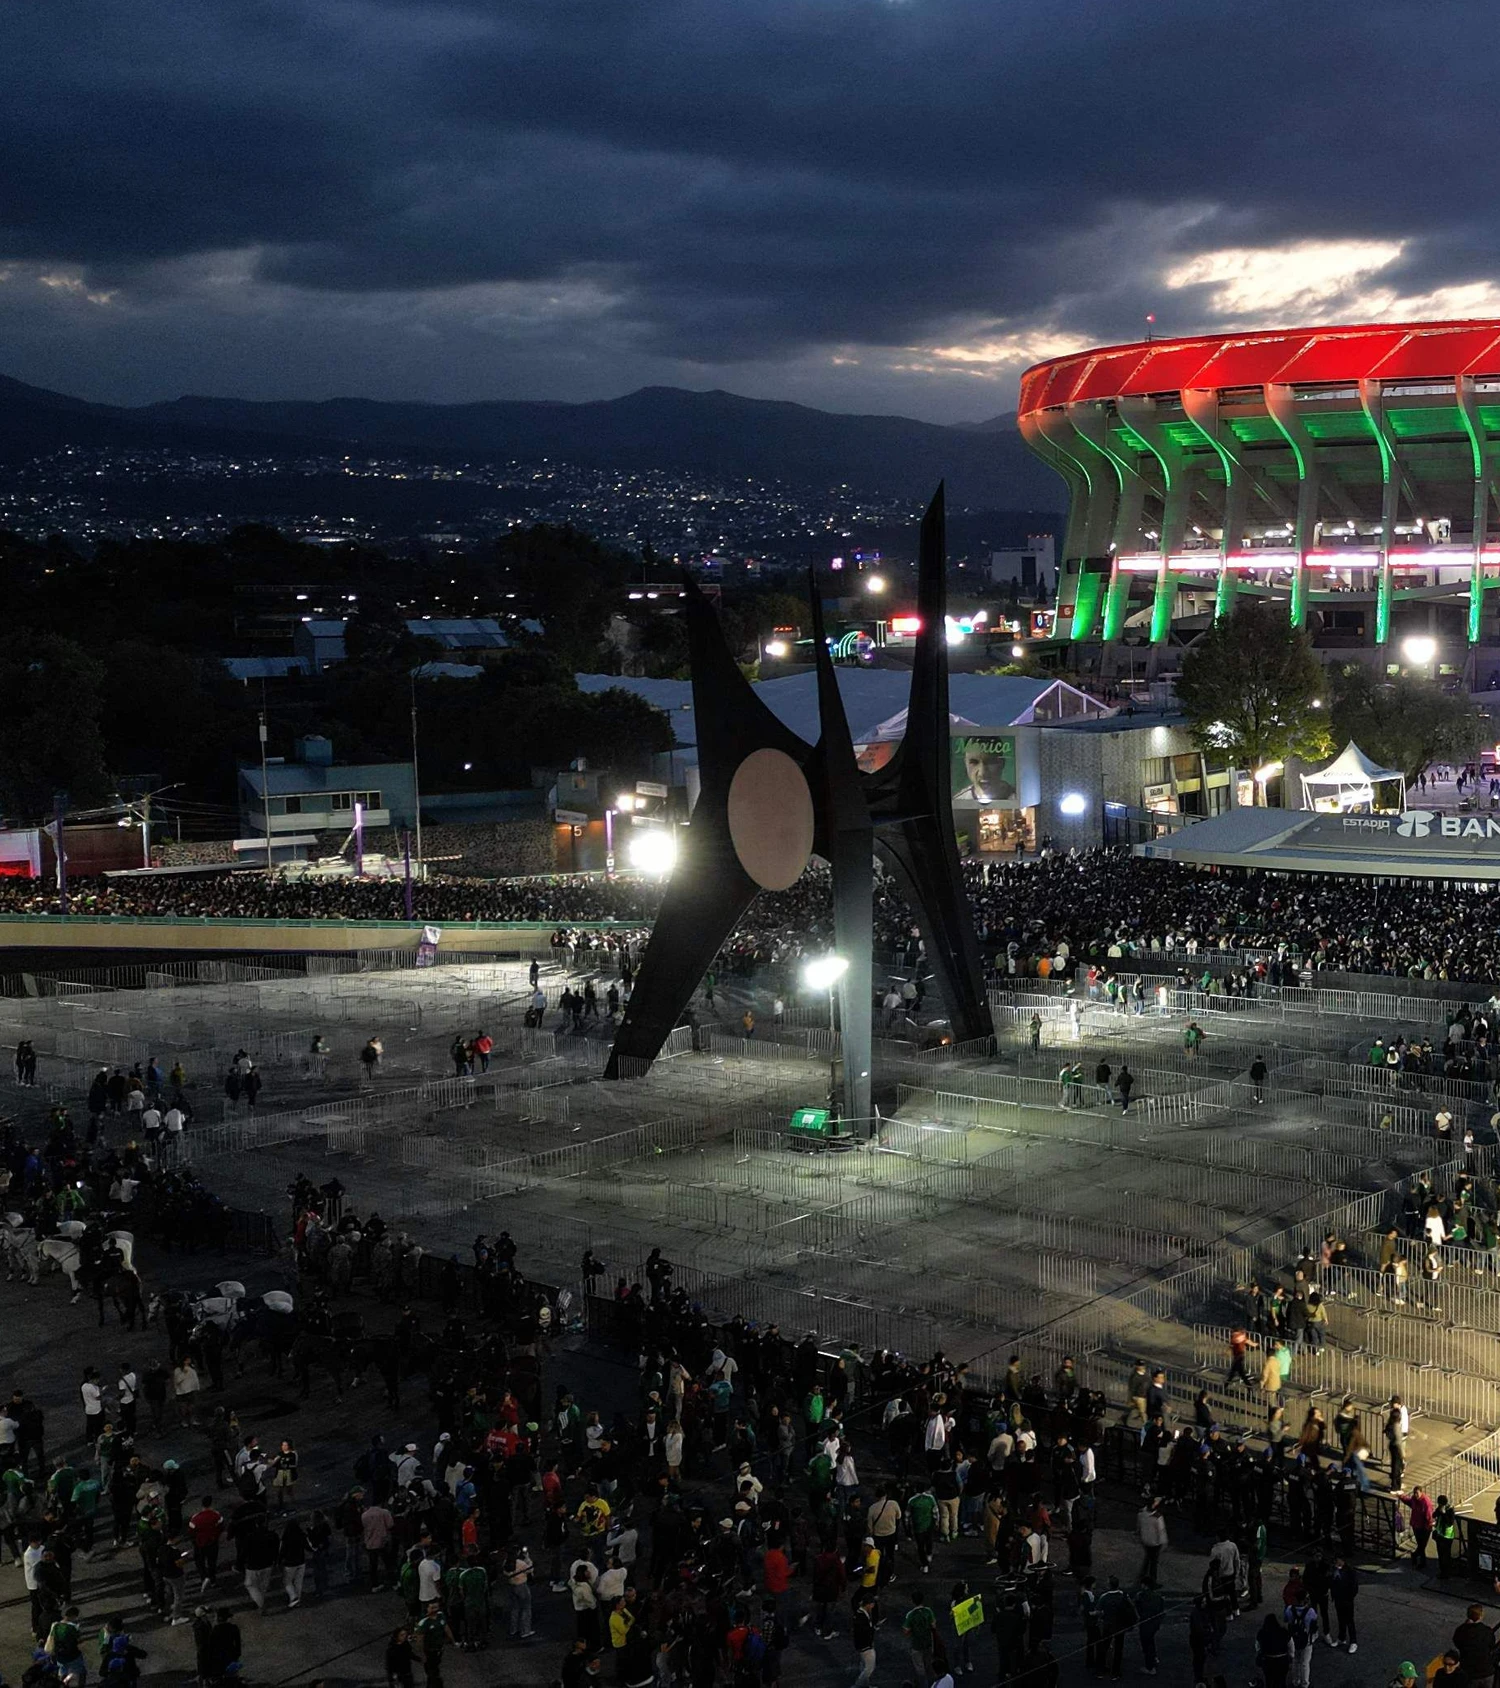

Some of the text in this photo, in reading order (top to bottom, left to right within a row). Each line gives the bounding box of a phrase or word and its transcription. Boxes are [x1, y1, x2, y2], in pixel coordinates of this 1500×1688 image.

[953, 737, 1012, 754] México
[1342, 818, 1390, 830] ESTADIO
[573, 825, 582, 837] 5
